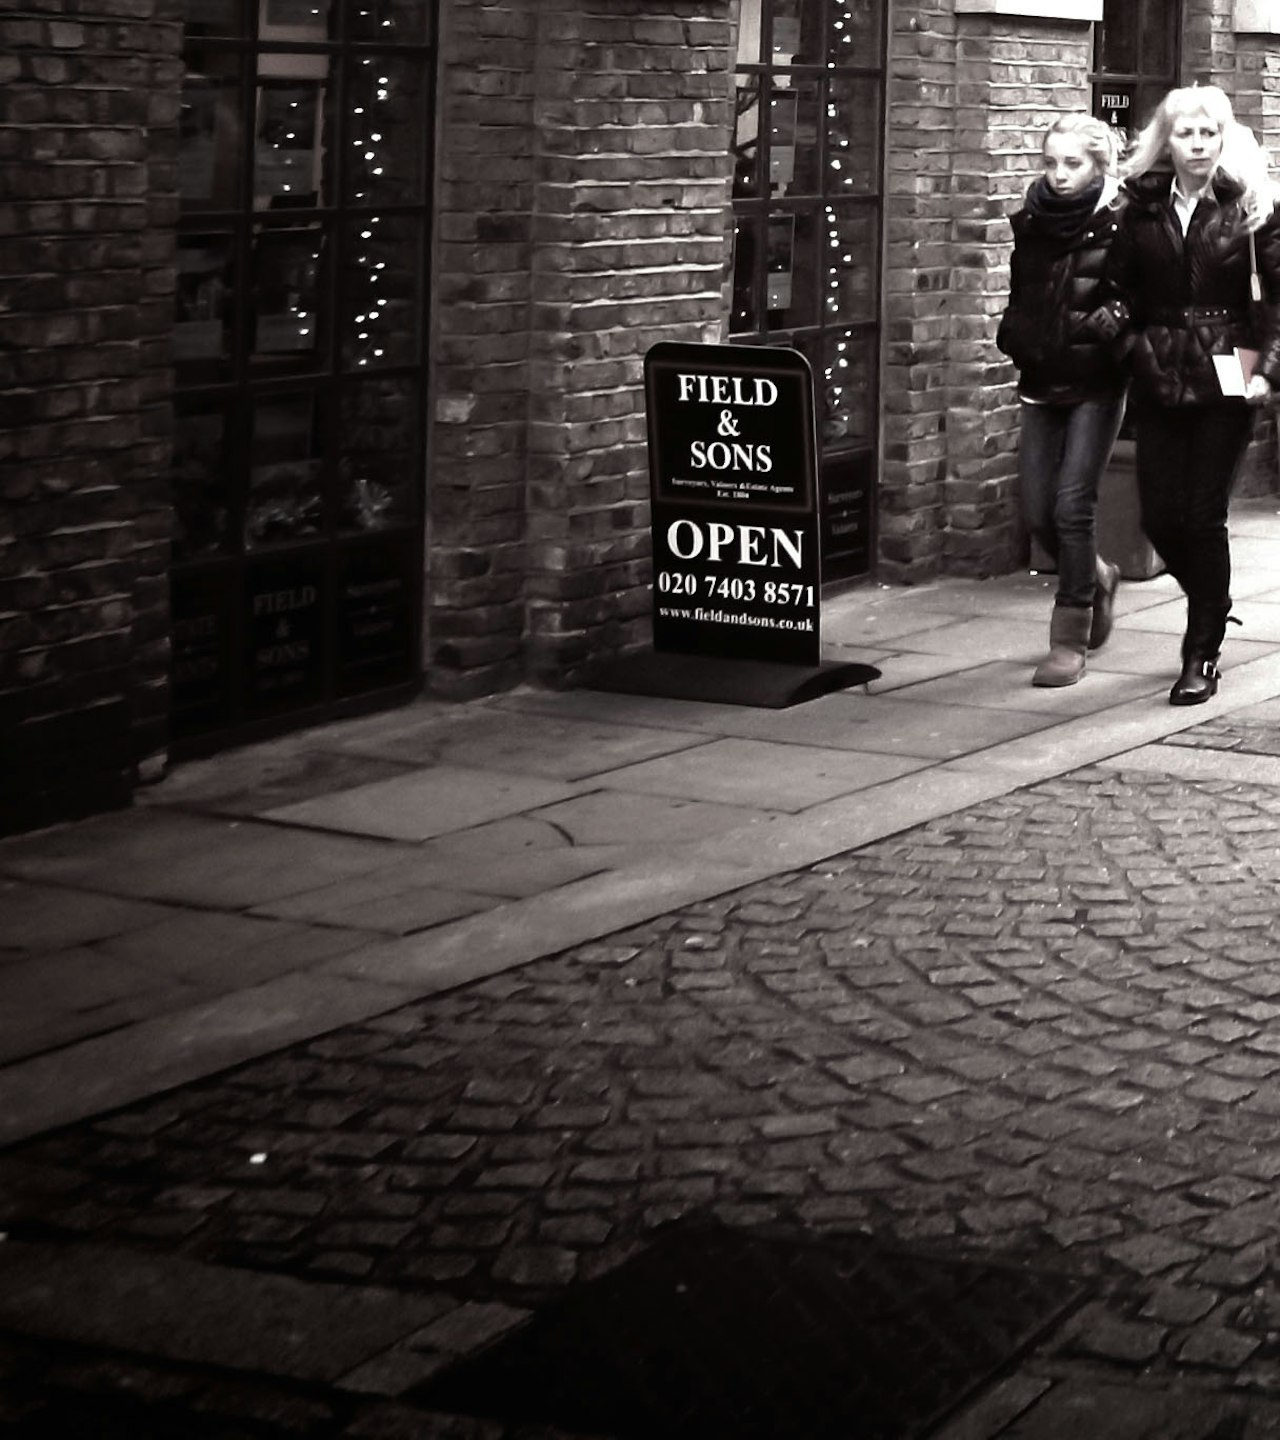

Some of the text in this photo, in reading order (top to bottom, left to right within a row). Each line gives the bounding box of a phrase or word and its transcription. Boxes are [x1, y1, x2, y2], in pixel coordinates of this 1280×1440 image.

[1101, 95, 1129, 108] FIELD
[677, 373, 778, 407] FIELD
[717, 409, 741, 437] &
[690, 440, 772, 472] SONS
[667, 519, 804, 569] OPEN
[658, 571, 814, 607] 020 7403 8571
[659, 607, 814, 631] www.fieldandsons.co.uk
